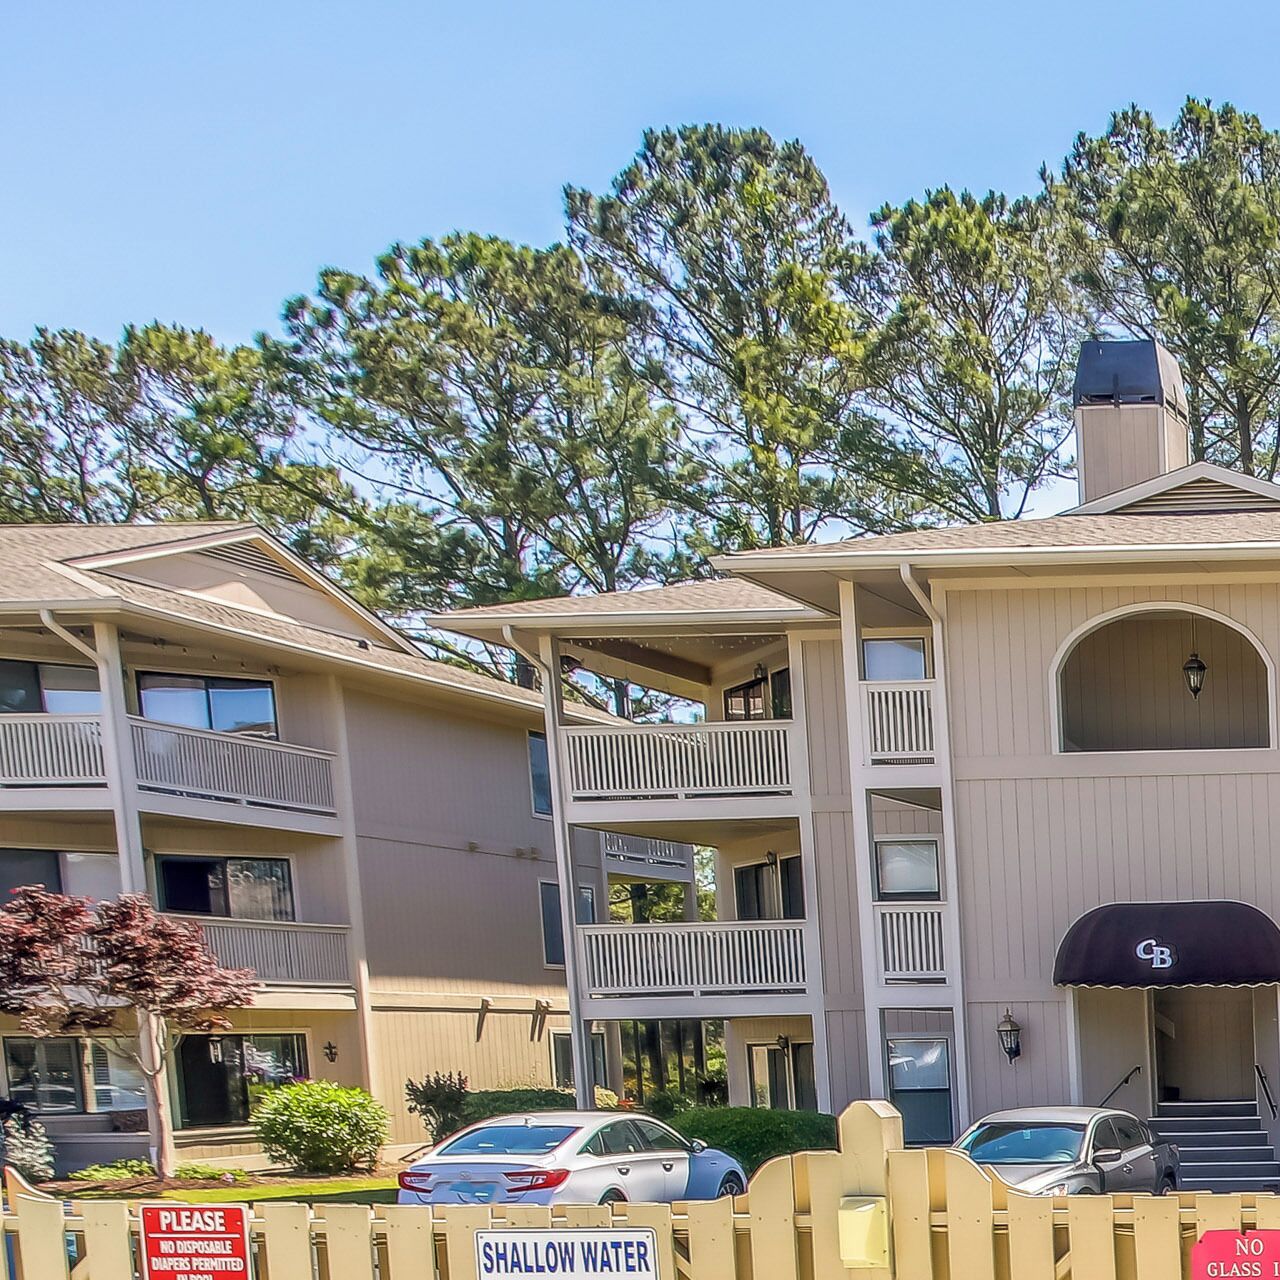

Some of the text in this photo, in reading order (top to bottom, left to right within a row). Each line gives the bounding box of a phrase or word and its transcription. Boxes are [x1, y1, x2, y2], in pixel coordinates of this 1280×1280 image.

[159, 1210, 226, 1232] PLEASE
[160, 1240, 233, 1255] NO DISPOSABLE
[1235, 1238, 1264, 1256] NO
[151, 1257, 244, 1271] DIAPERS PERMITTED
[483, 1241, 651, 1274] SHALLOW WATER
[1207, 1262, 1262, 1277] GLASS
